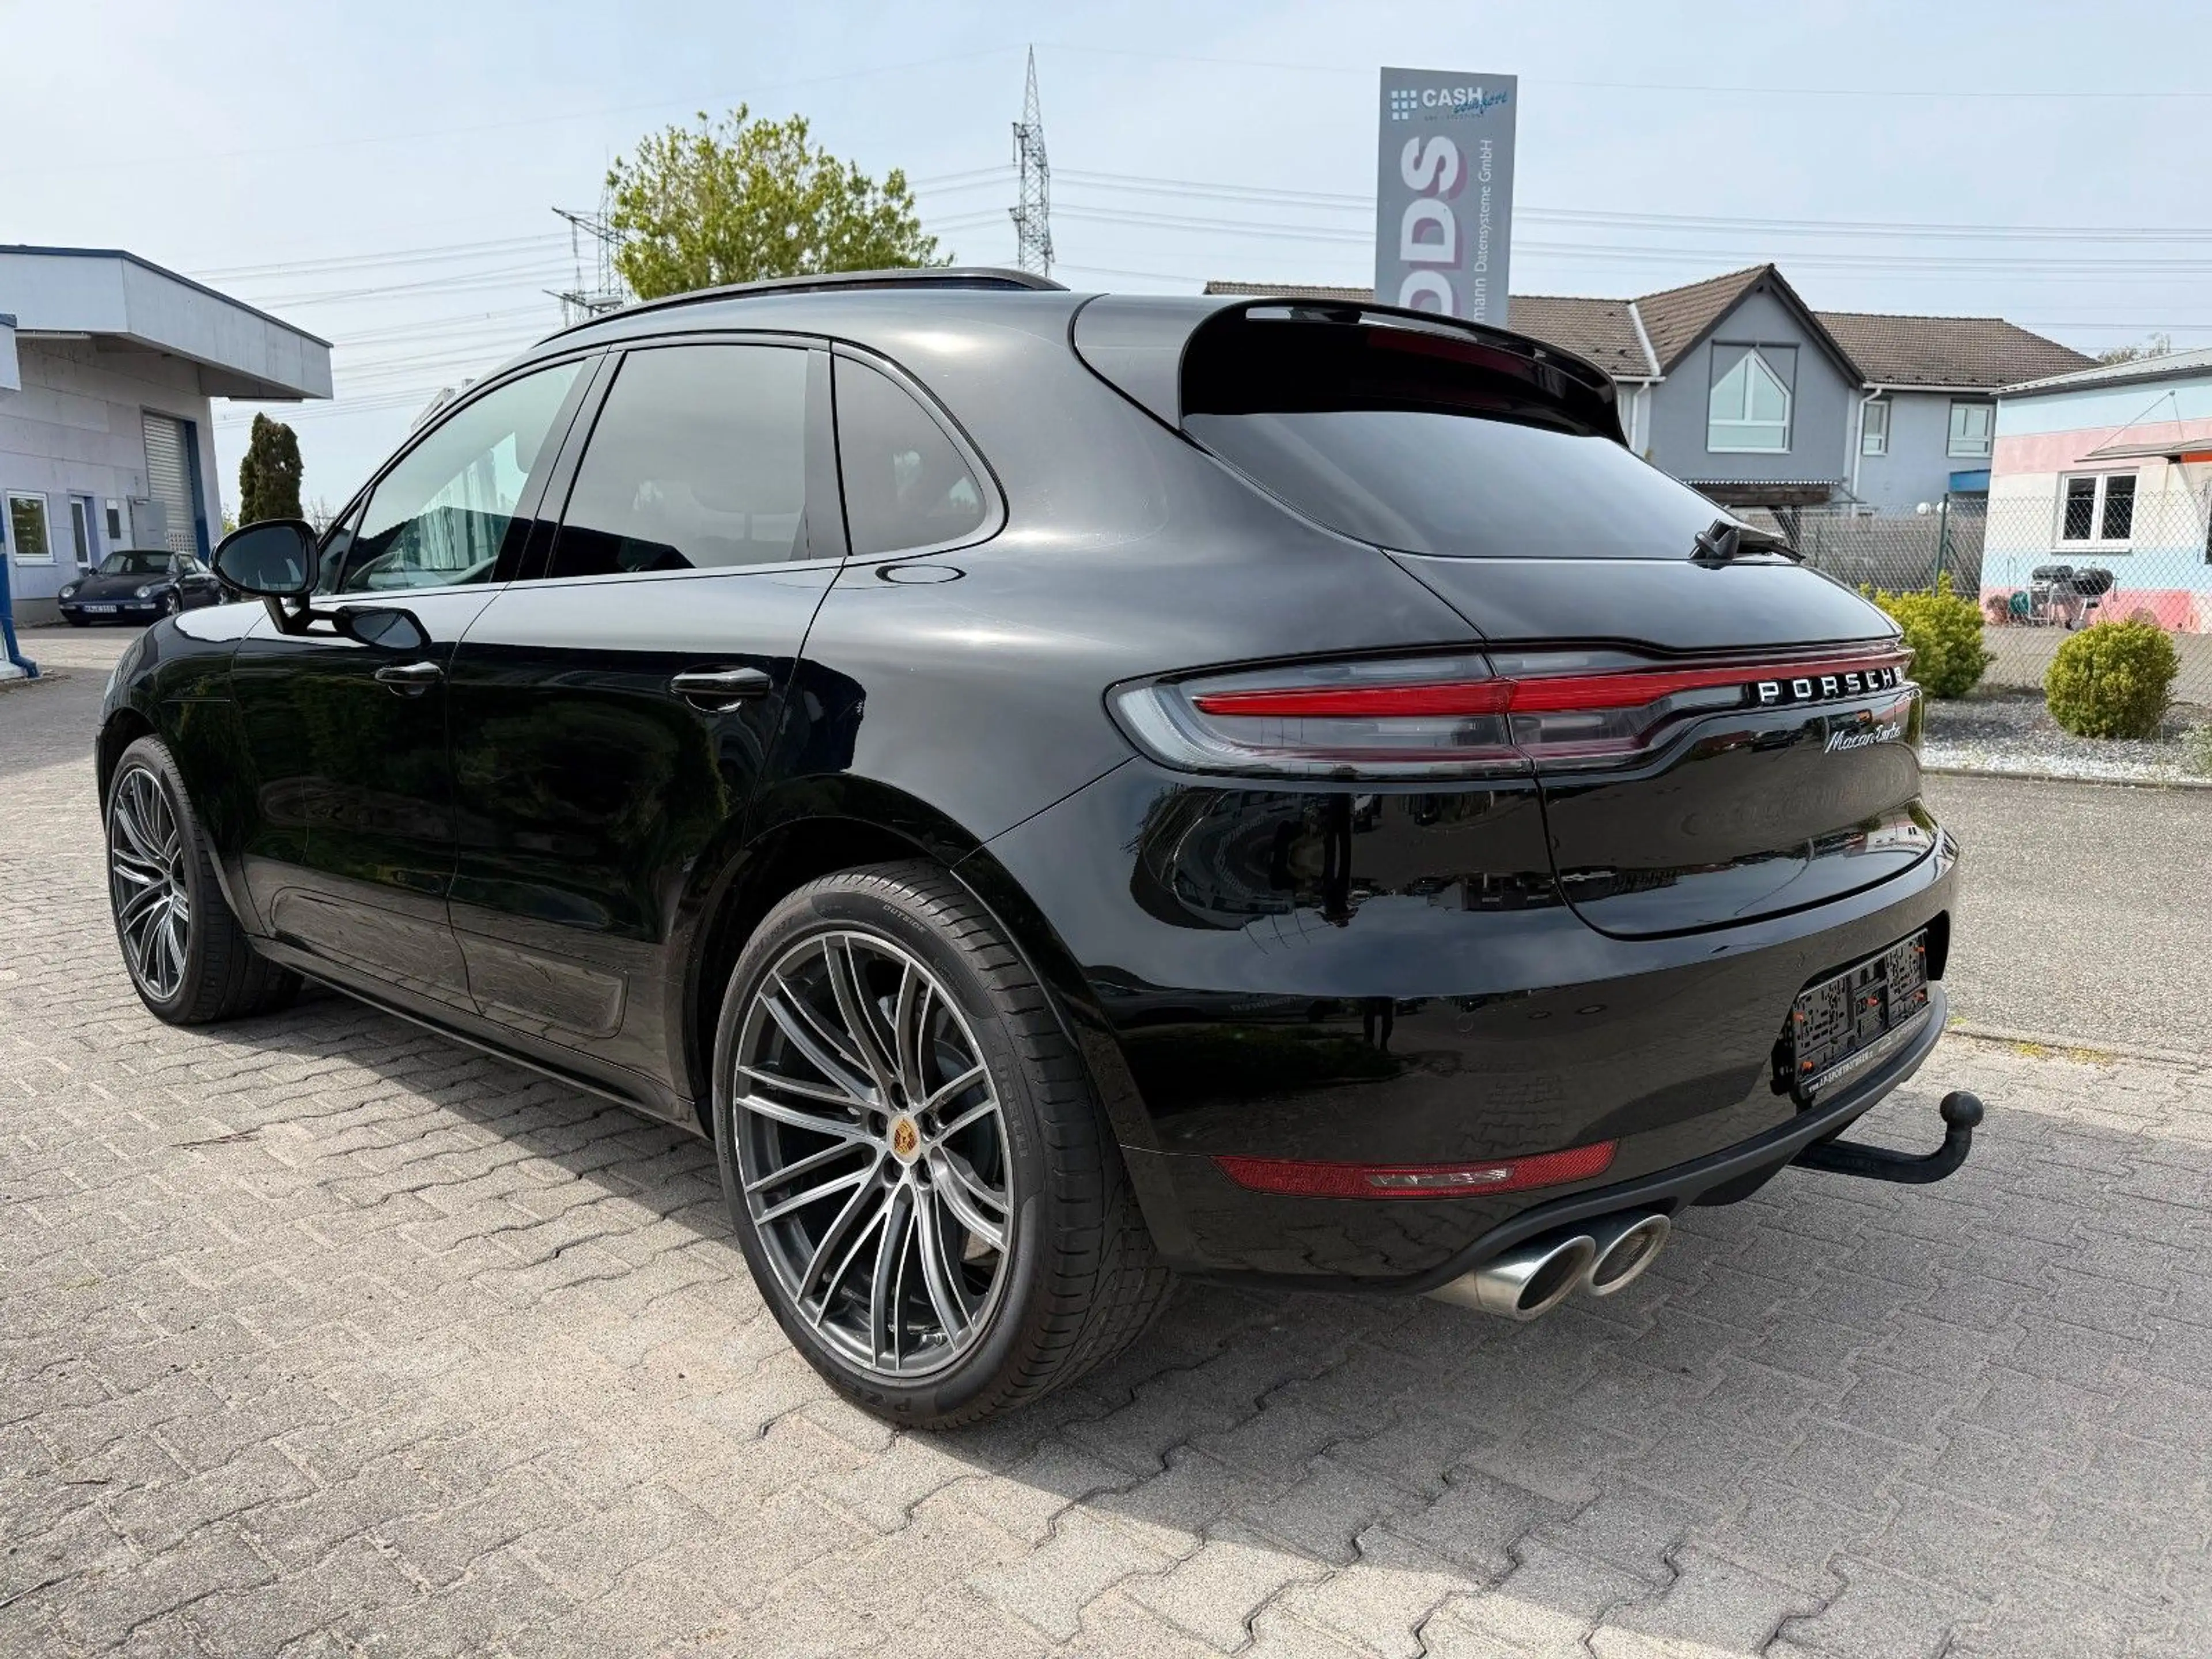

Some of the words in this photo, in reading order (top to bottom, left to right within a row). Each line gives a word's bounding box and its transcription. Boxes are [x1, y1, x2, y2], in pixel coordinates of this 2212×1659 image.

[1422, 86, 1483, 107] CASH
[1478, 139, 1493, 181] GmbH
[1474, 186, 1493, 273] Datensysteme
[1758, 666, 1903, 702] PORSCHE
[1824, 730, 1874, 753] Macan
